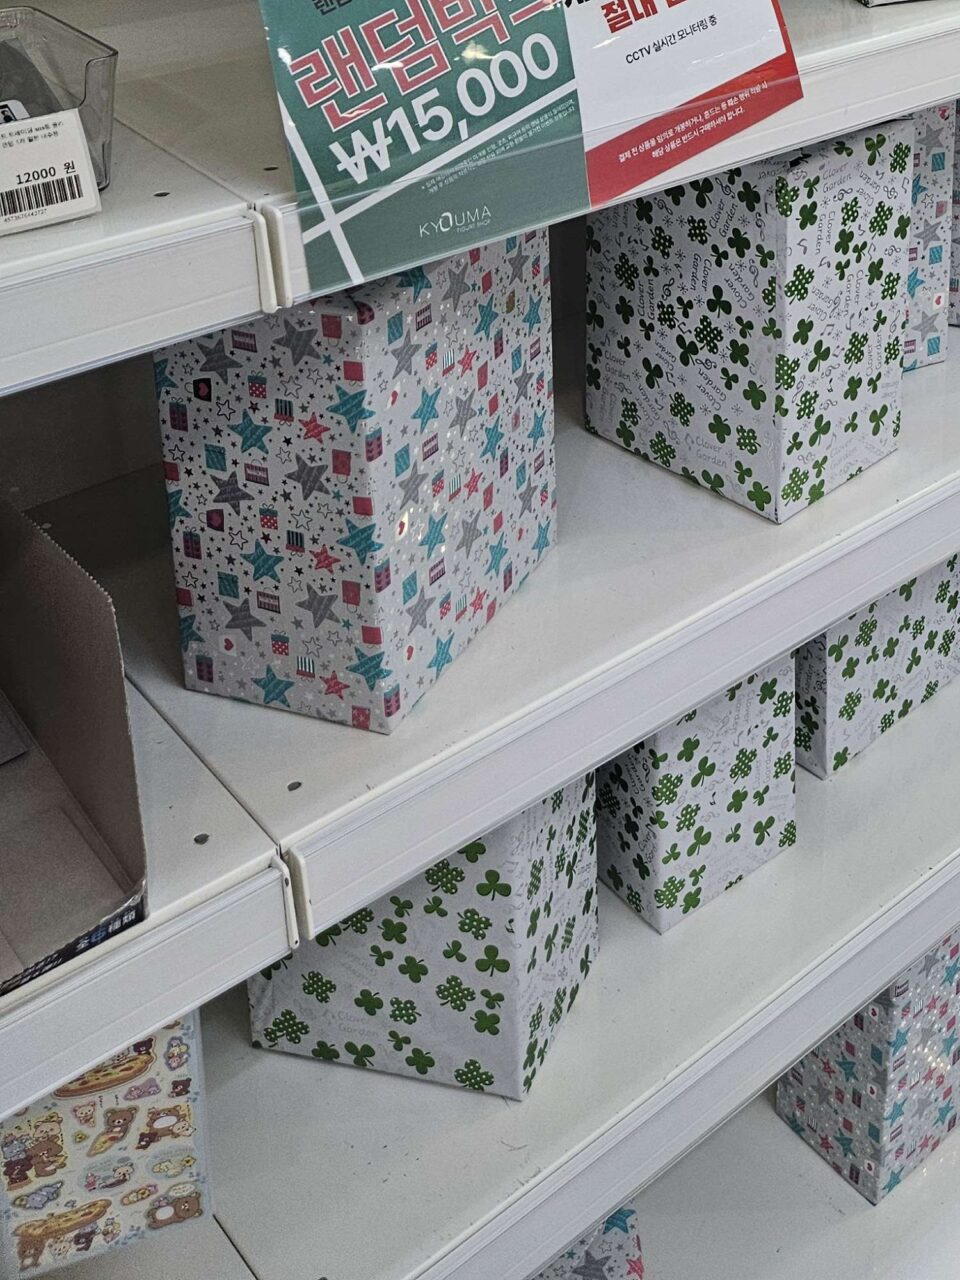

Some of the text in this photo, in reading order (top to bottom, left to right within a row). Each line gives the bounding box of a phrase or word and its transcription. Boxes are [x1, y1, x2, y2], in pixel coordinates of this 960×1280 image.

[625, 14, 719, 66] CCTV 실시간 모니터링 중
[328, 32, 559, 185] ₩15,000
[631, 145, 639, 156] 전
[681, 130, 700, 144] 반드시
[16, 160, 77, 185] 12000 원
[823, 162, 849, 180] Clover
[823, 173, 852, 194] Garden
[418, 205, 492, 238] KYOUMA
[709, 199, 726, 230] Clover
[719, 202, 738, 238] Garden
[826, 210, 835, 246] Clover
[815, 213, 825, 255] Garden
[690, 253, 702, 291] Garden
[702, 258, 713, 292] Clover
[729, 264, 755, 302] Garden
[637, 281, 646, 317] Clover
[724, 277, 747, 309] Clover
[811, 285, 834, 309] Garden
[854, 270, 864, 306] Clover
[807, 301, 827, 321] Clover
[604, 350, 626, 366] Clover
[654, 339, 676, 363] Garden
[655, 351, 674, 371] Clover
[696, 383, 722, 411] Clover
[698, 369, 727, 402] Garden
[696, 436, 722, 451] Clover
